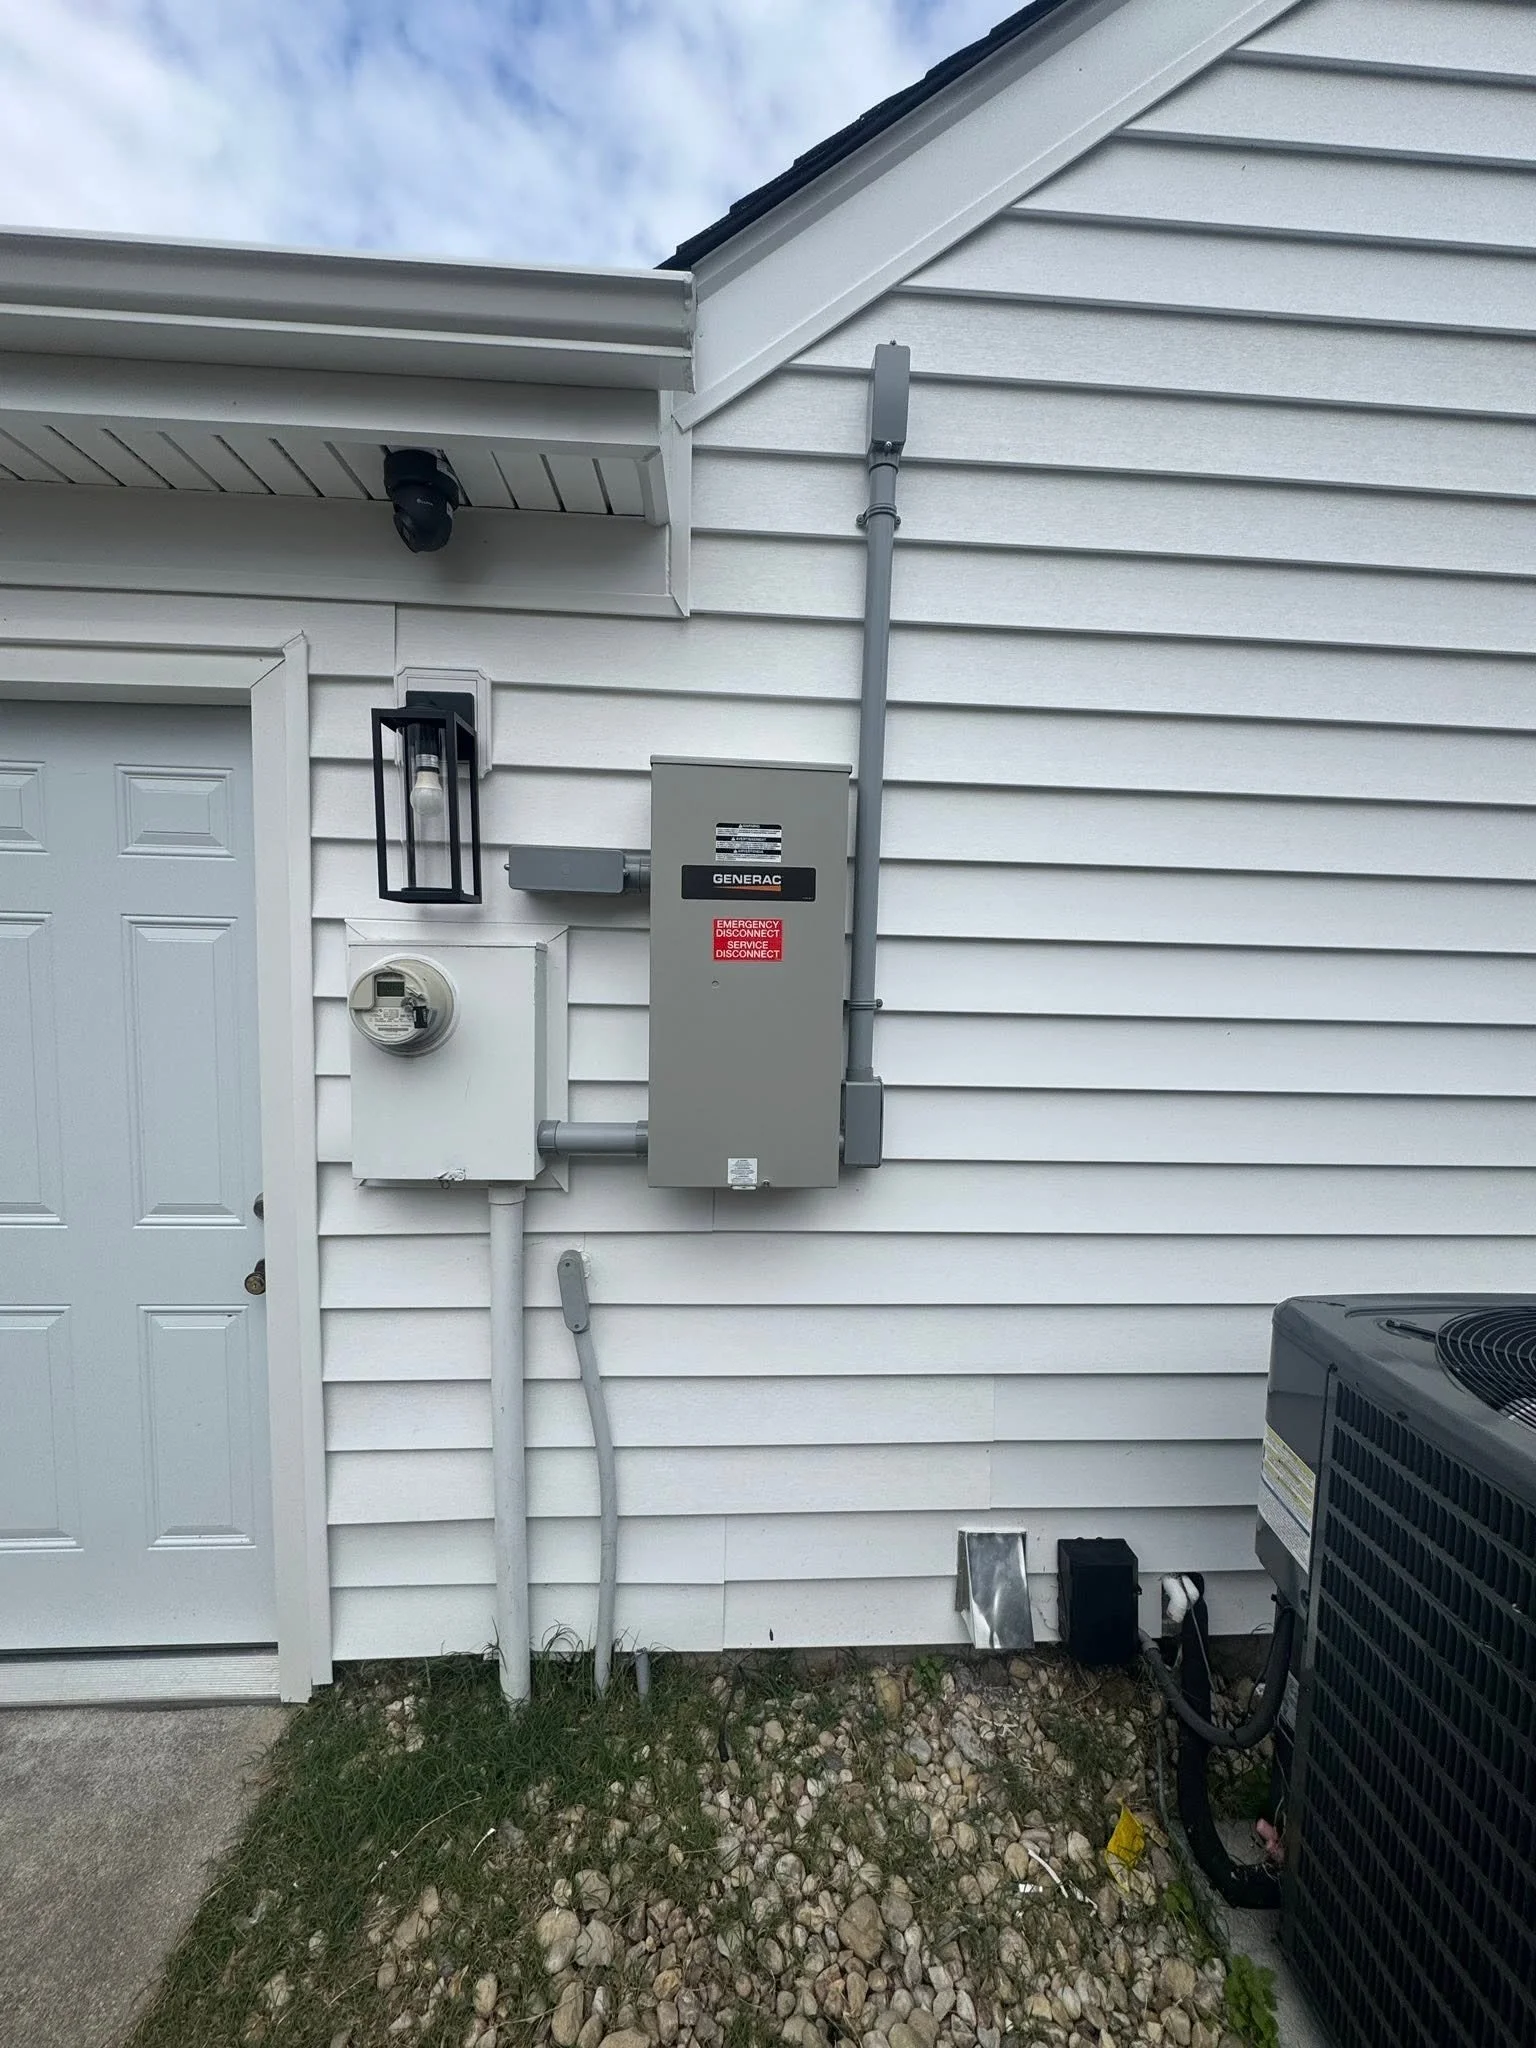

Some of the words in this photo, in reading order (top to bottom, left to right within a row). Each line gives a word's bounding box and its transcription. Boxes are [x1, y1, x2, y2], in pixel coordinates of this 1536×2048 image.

[713, 874, 782, 885] GENERAC
[716, 920, 780, 929] EMERGENCY
[715, 929, 780, 938] DISCONNECT
[727, 940, 769, 950] SERVICE
[715, 949, 780, 959] DISCONNECT
